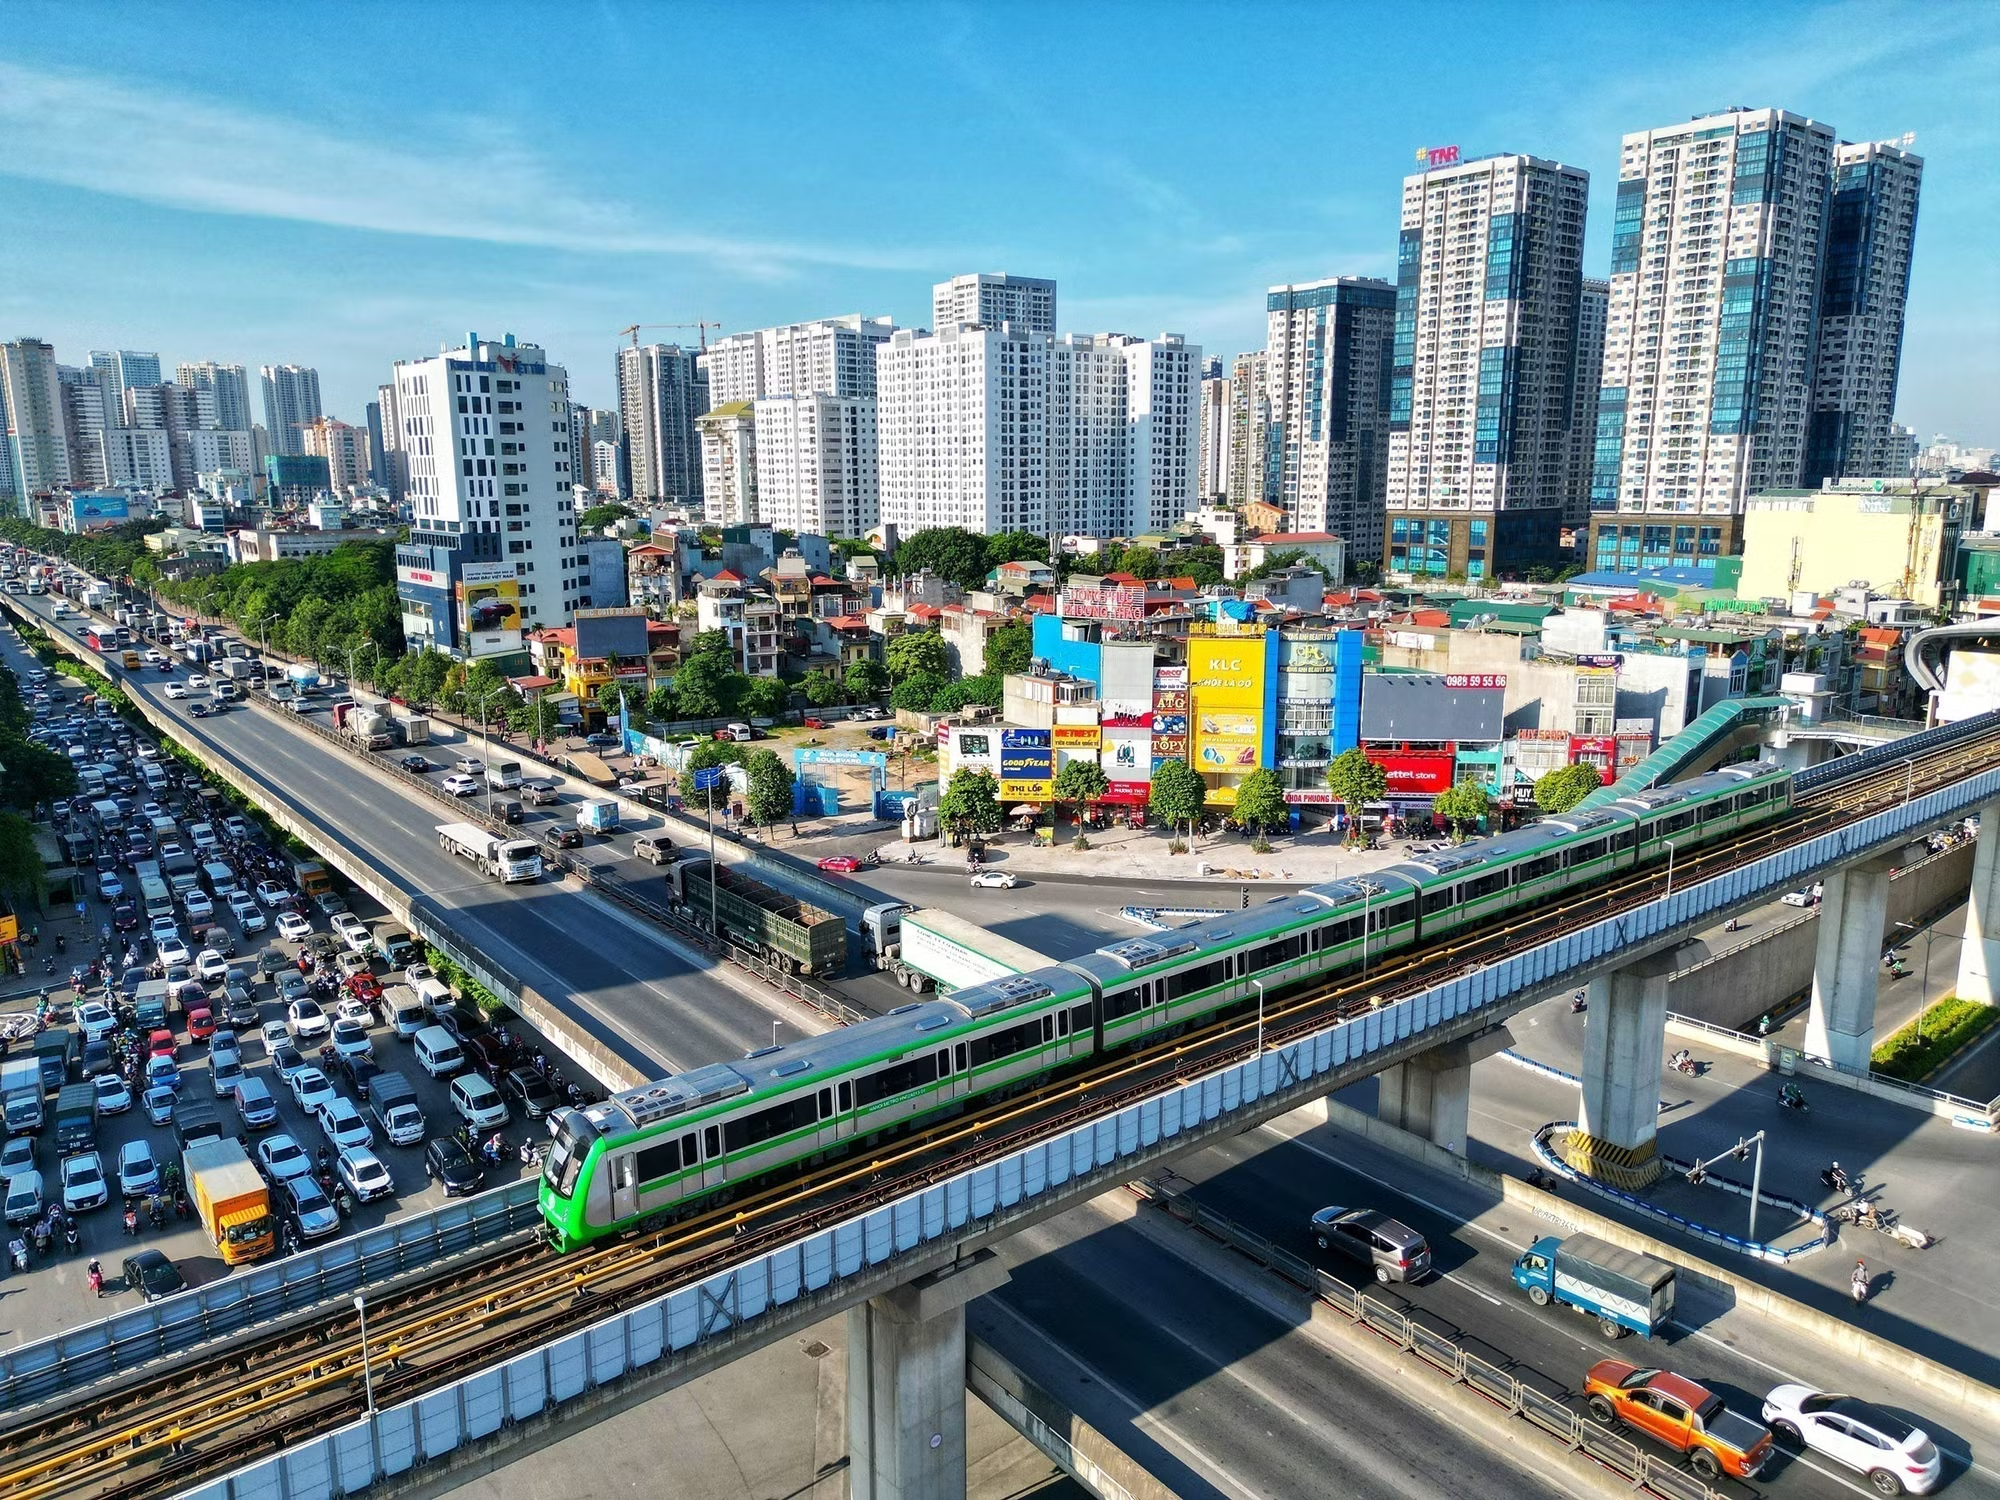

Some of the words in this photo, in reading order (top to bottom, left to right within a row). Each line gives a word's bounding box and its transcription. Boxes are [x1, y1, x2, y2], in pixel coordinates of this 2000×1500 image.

[1428, 146, 1459, 166] TNR
[1209, 659, 1242, 671] KLC
[1469, 675, 1481, 687] 59
[1482, 676, 1494, 687] 55
[1495, 676, 1506, 687] 66
[1157, 699, 1185, 708] ATG
[1538, 731, 1568, 740] SPORT
[1152, 740, 1186, 750] TOPY
[1002, 758, 1050, 767] GOODYEAR
[1515, 788, 1532, 798] HUY
